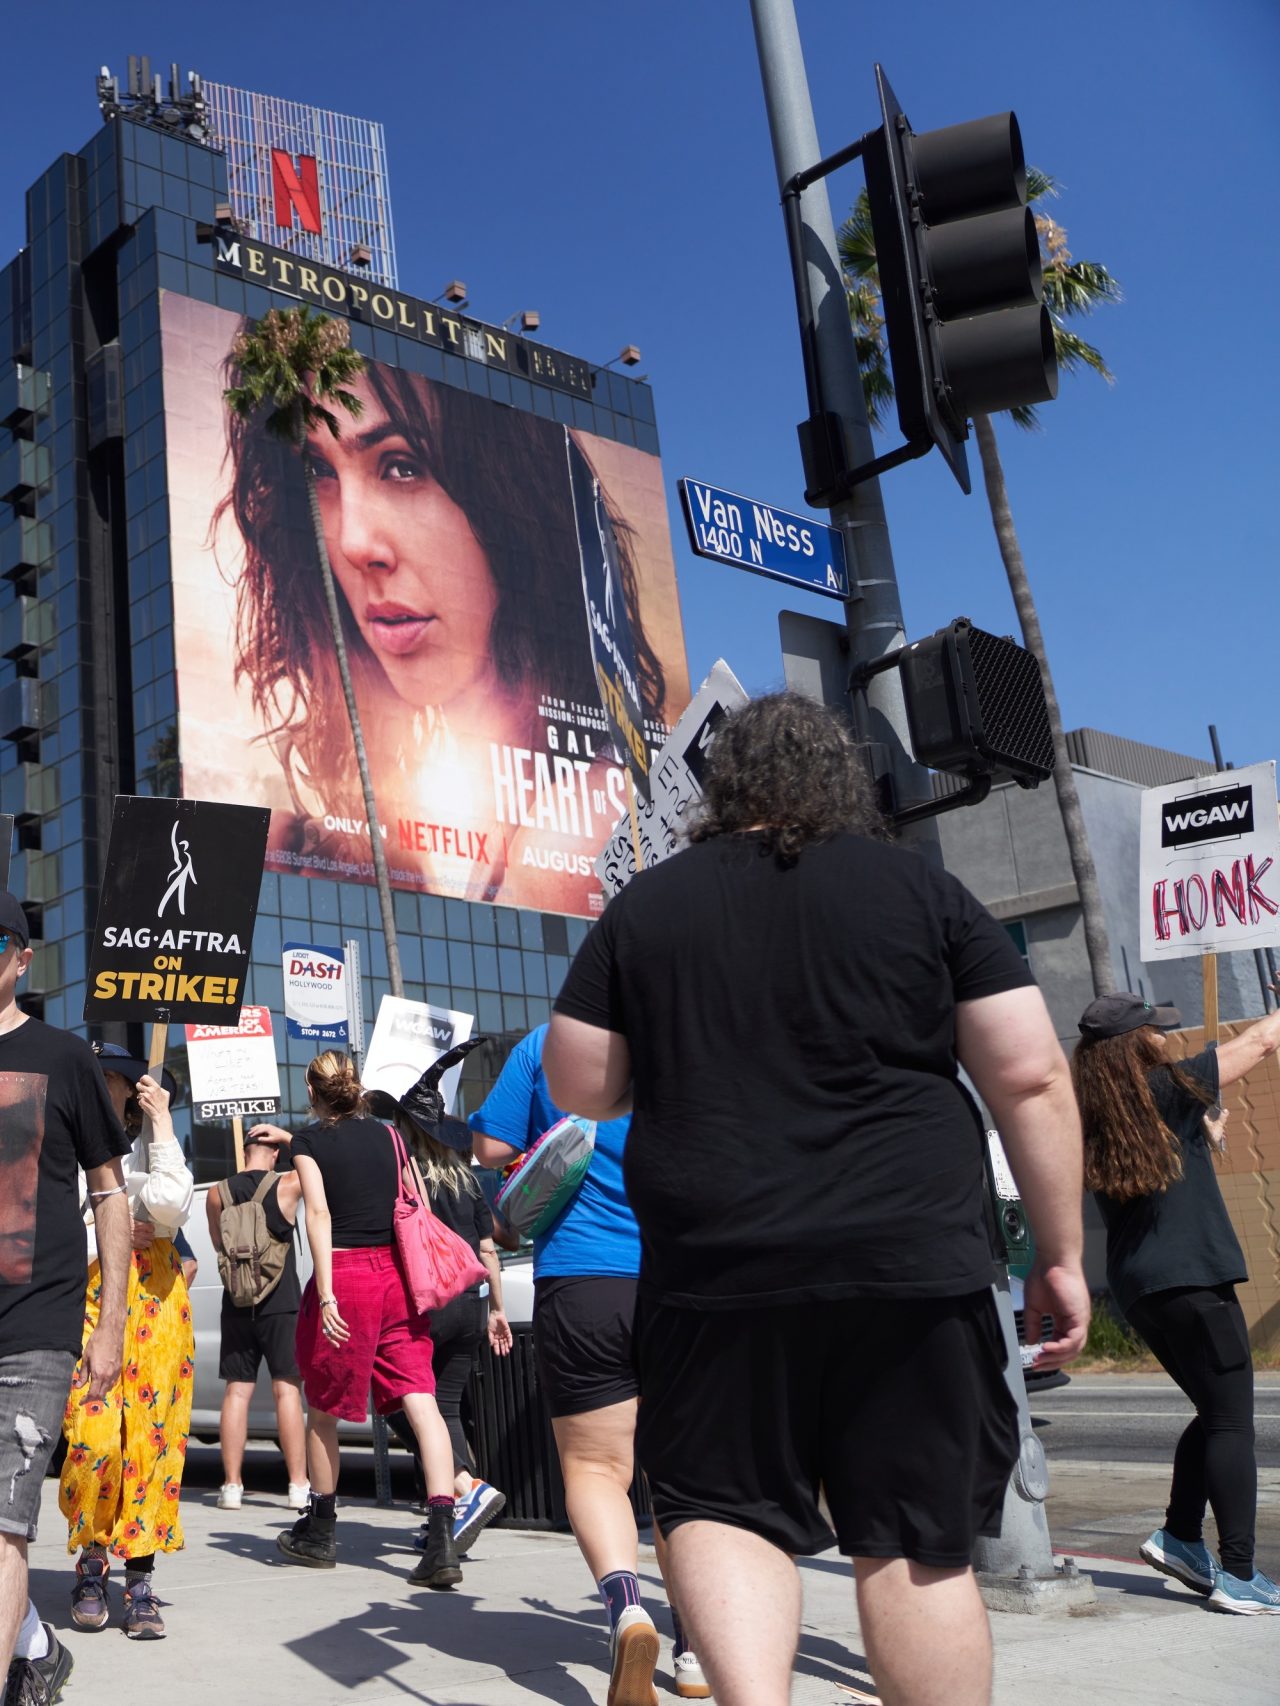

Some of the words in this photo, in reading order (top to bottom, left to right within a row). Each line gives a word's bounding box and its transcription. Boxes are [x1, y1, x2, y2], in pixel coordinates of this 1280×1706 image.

[216, 238, 507, 362] METROPOLITN
[695, 485, 743, 533] Van
[753, 505, 814, 556] Ness
[700, 523, 742, 558] 1400
[750, 538, 763, 565] N
[571, 702, 609, 722] EXECUT
[577, 715, 609, 732] IMPOSSI
[547, 725, 596, 758] GAL
[490, 743, 594, 838] HEART
[593, 789, 607, 815] OF
[1165, 800, 1249, 832] WGAW
[324, 815, 363, 835] ONLY
[397, 818, 490, 866] NETFLIX
[1152, 853, 1279, 941] HONK
[154, 955, 182, 971] ON
[289, 960, 342, 980] DASH
[93, 971, 239, 1004] STRIKE!
[289, 980, 332, 990] HOLLYWOOD
[192, 1025, 266, 1038] AMERICA
[394, 1016, 451, 1041] WGAW
[201, 1099, 276, 1118] STRIKE
